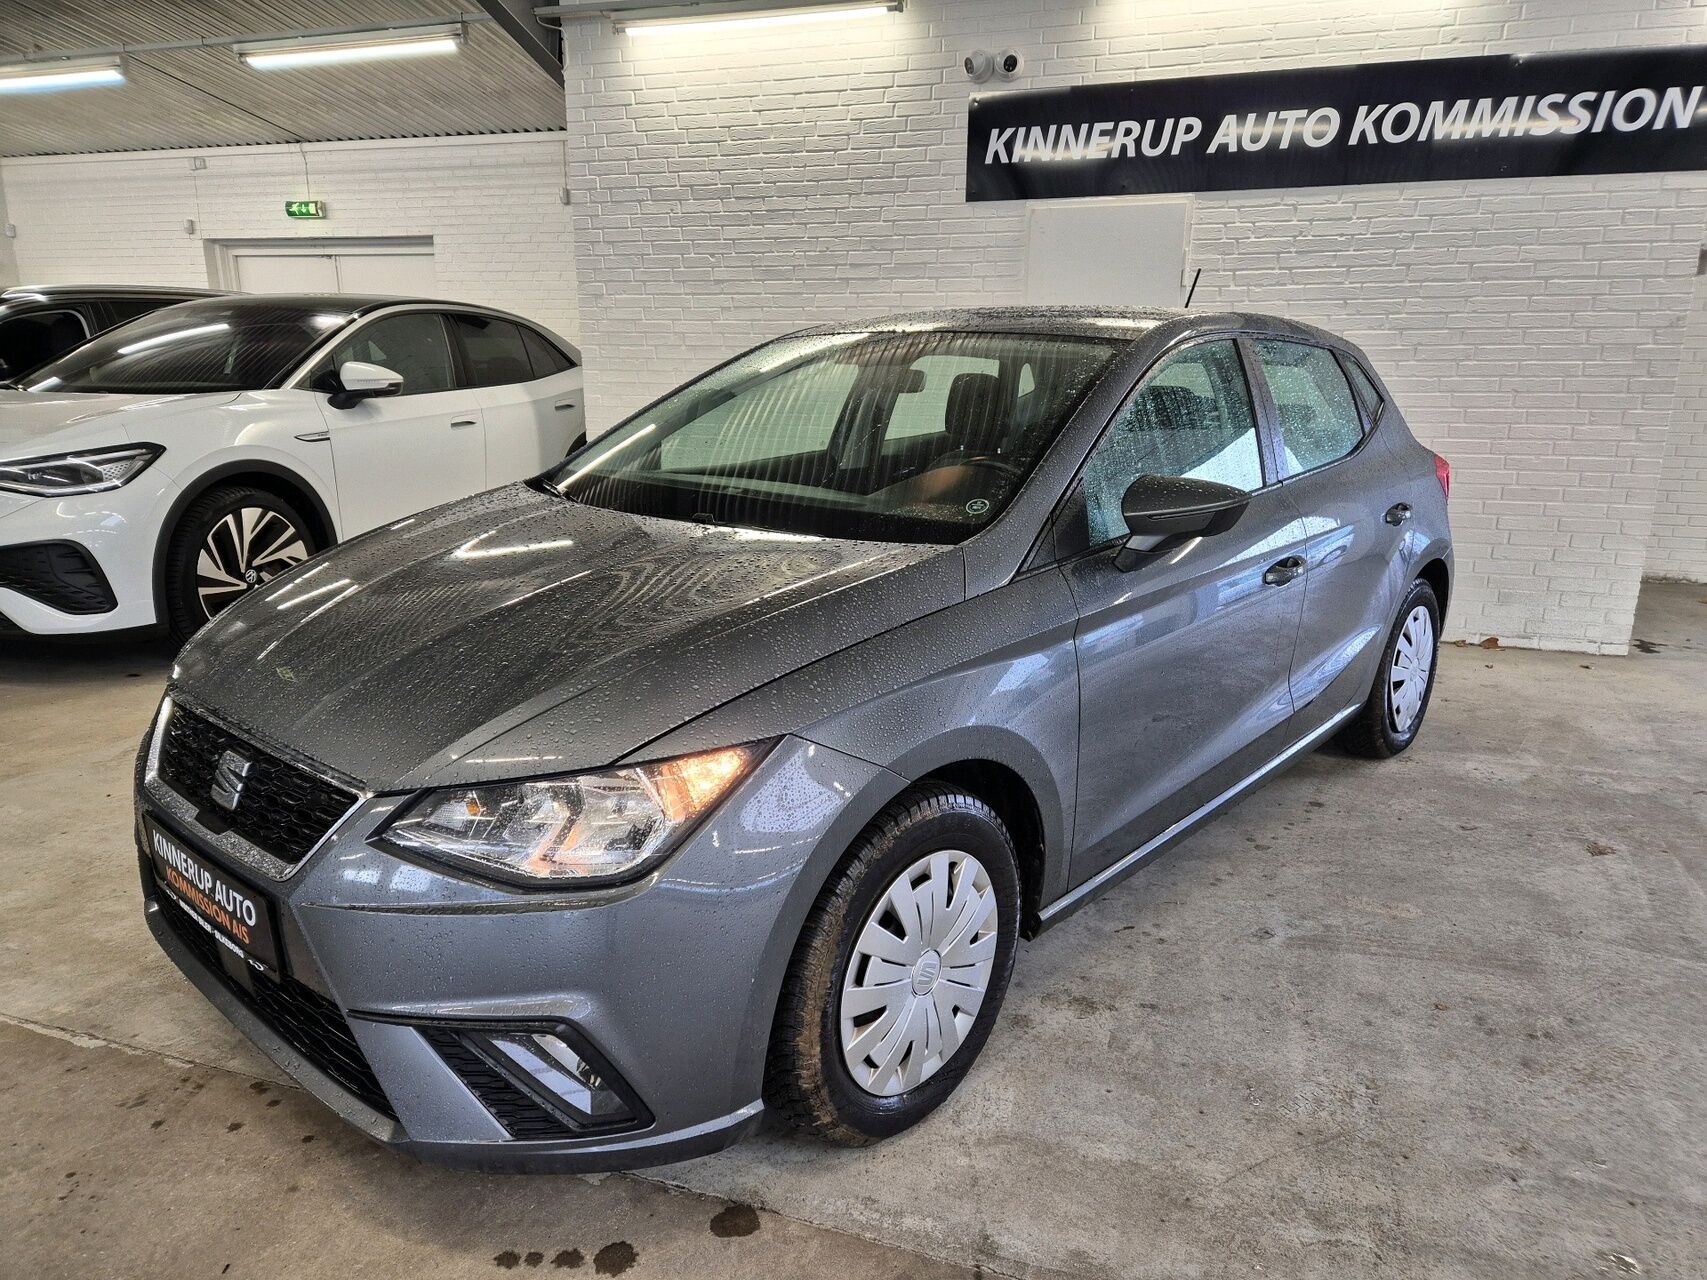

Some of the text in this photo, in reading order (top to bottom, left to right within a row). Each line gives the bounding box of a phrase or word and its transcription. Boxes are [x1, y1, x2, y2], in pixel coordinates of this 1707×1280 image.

[984, 85, 1704, 165] KINNERUP AUTO KOMMISSION
[152, 829, 213, 896] KINNERUP
[214, 879, 256, 927] AUTO
[165, 864, 232, 931] KOMMISSION
